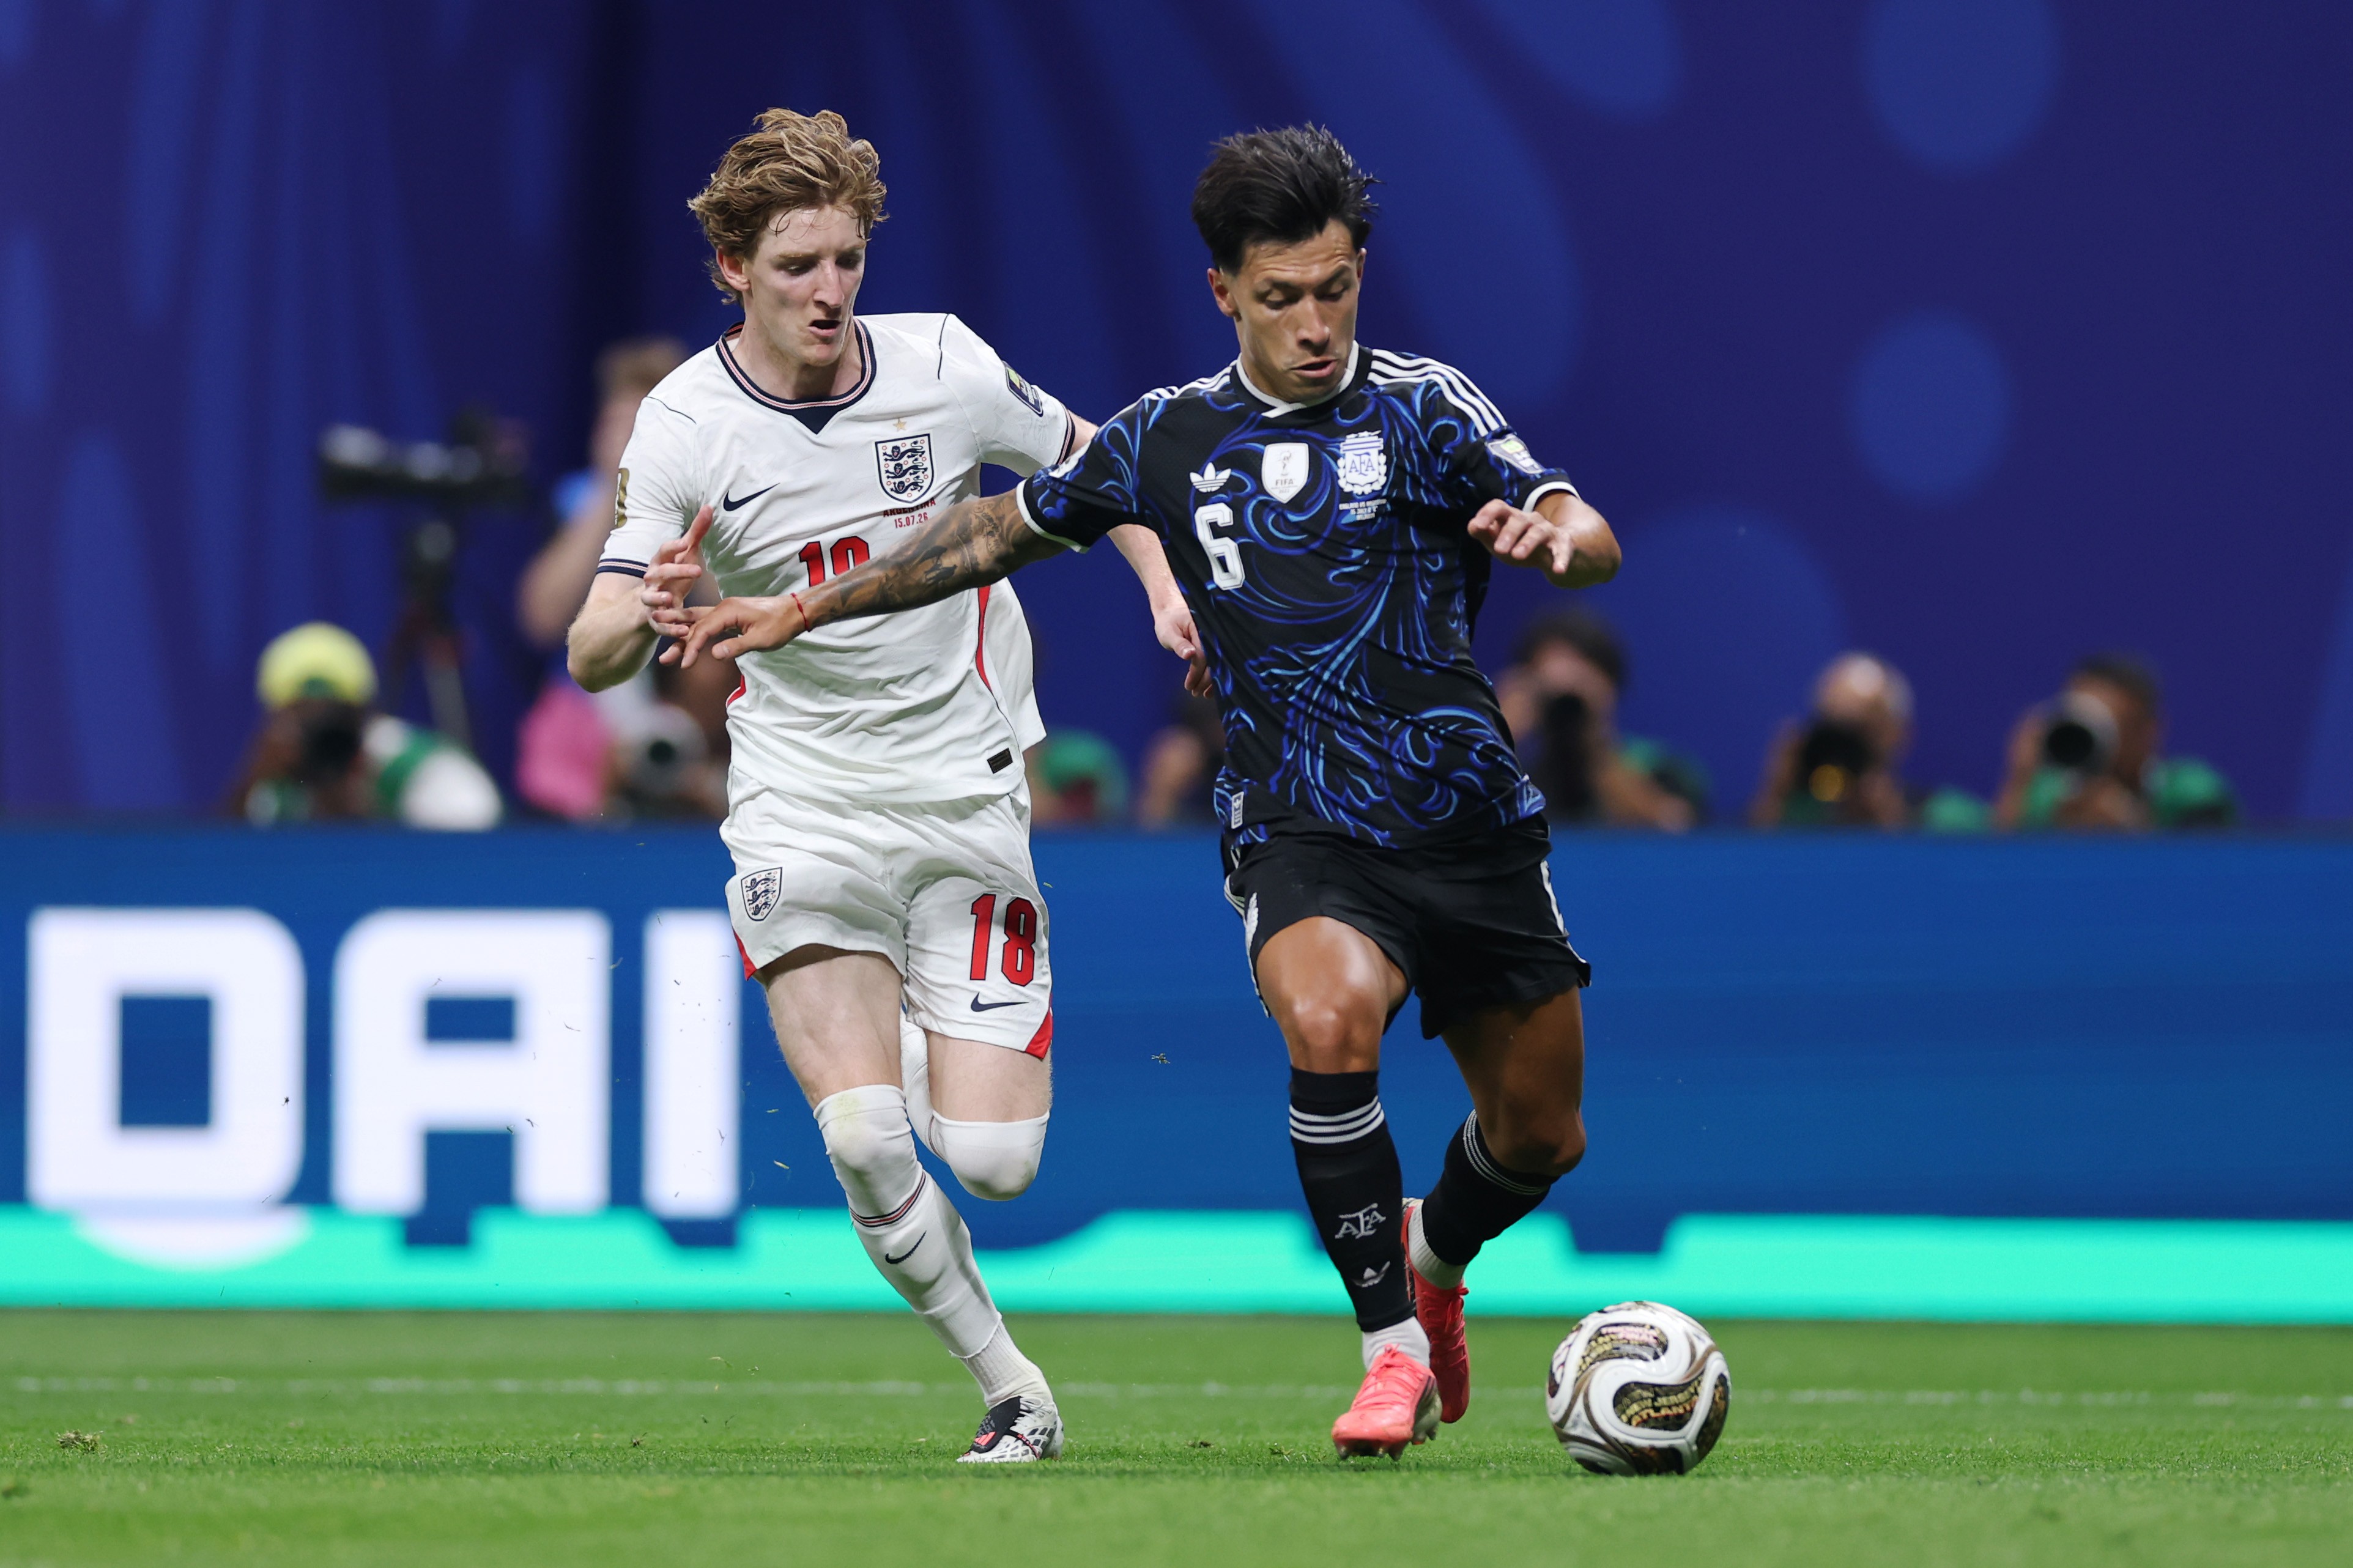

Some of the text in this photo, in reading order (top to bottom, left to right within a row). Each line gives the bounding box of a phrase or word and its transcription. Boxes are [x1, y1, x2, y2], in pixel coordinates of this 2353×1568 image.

[1349, 452, 1376, 476] AFA
[894, 512, 928, 529] 15.07.26
[1195, 502, 1245, 591] 6
[969, 893, 1037, 987] 18
[26, 906, 741, 1218] DAI
